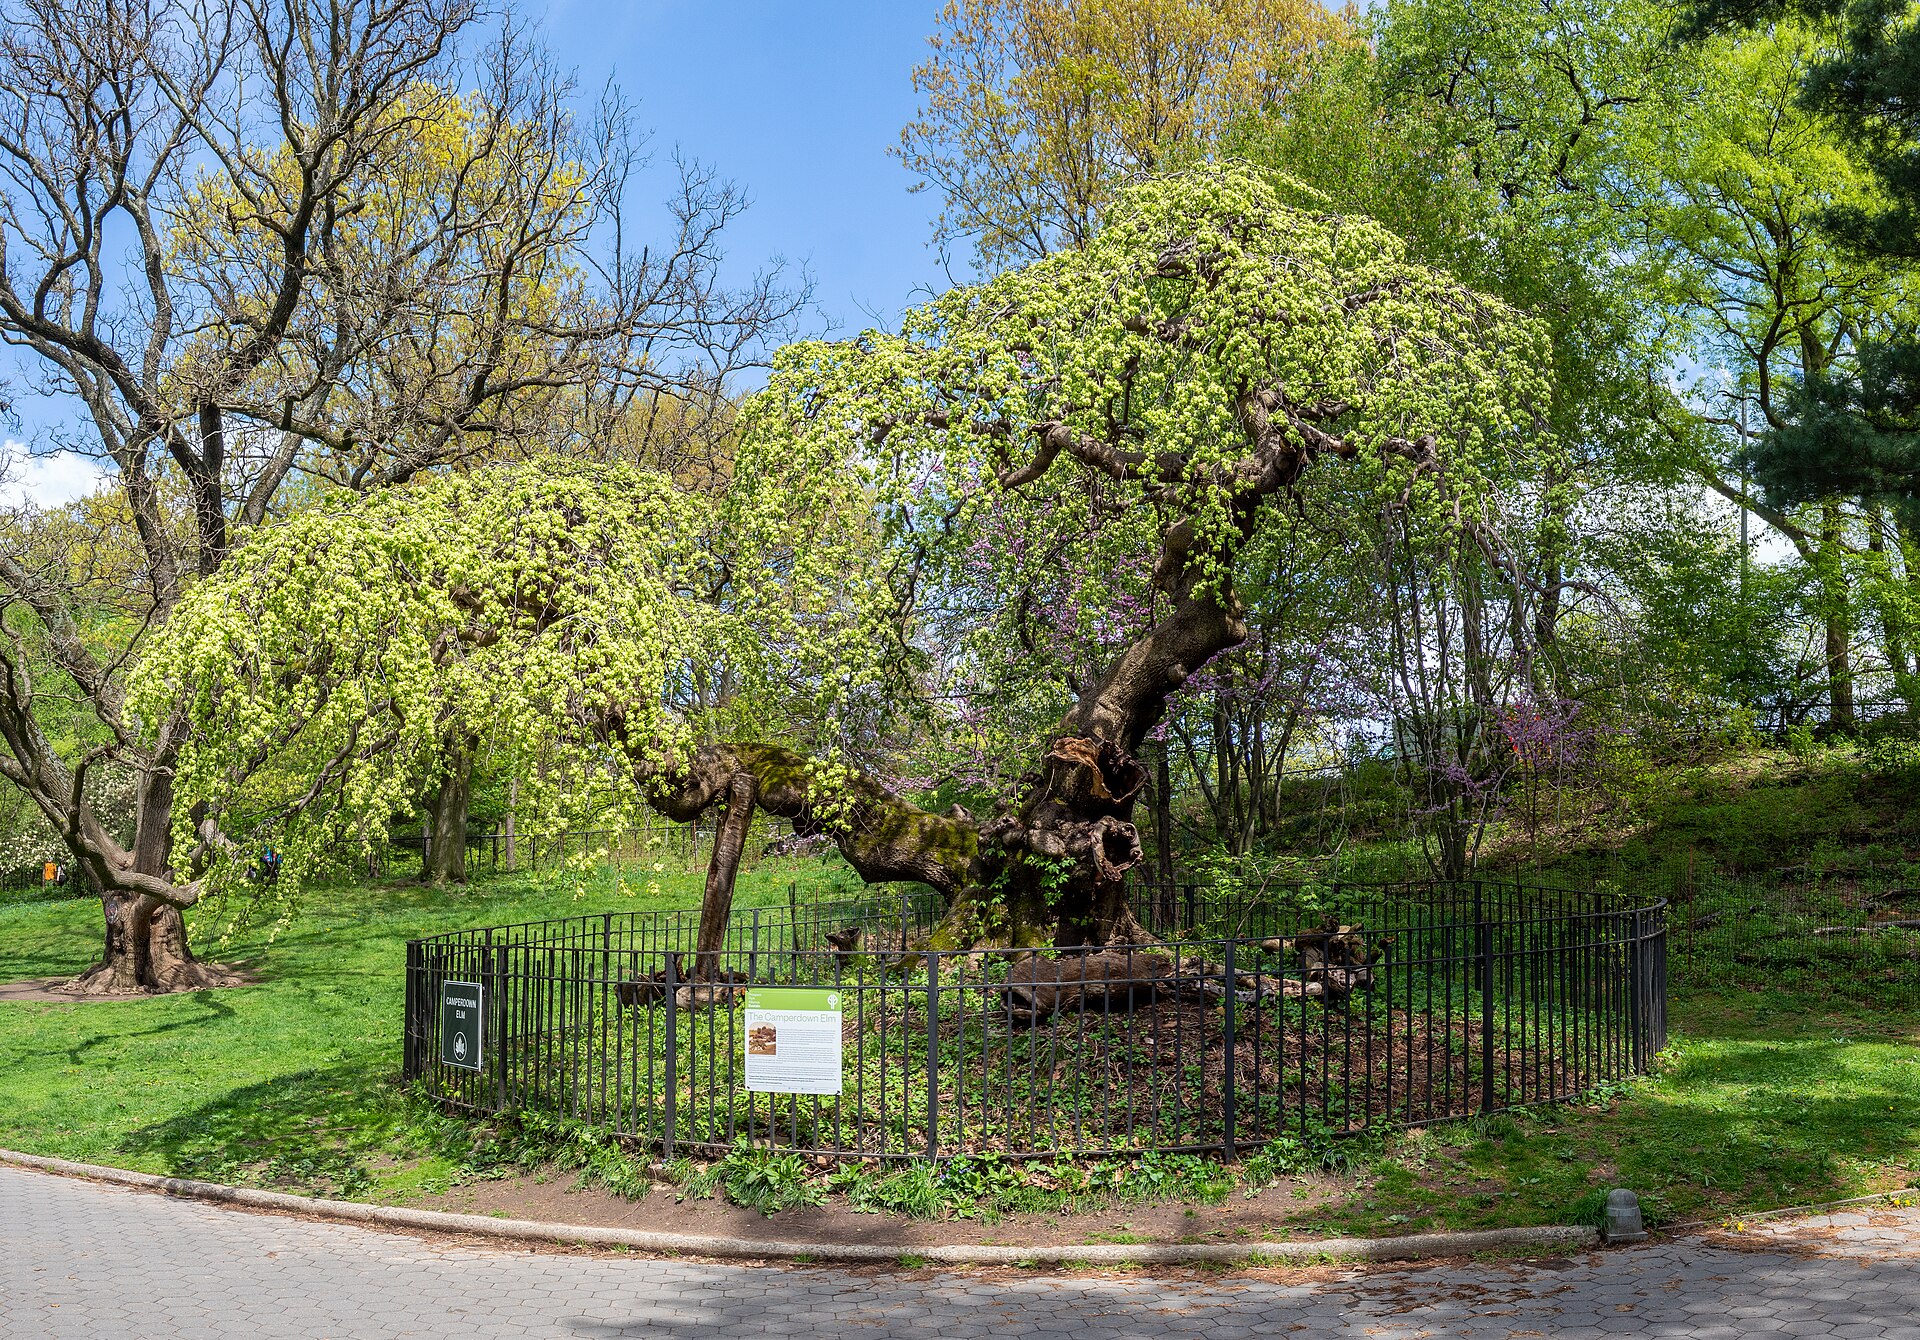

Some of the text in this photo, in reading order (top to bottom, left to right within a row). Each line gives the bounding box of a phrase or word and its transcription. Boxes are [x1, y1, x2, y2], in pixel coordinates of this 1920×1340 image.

[446, 996, 477, 1008] CAMPERDOWN
[455, 1009, 466, 1019] ELM
[748, 1012, 836, 1022] The Camperdown Elm
